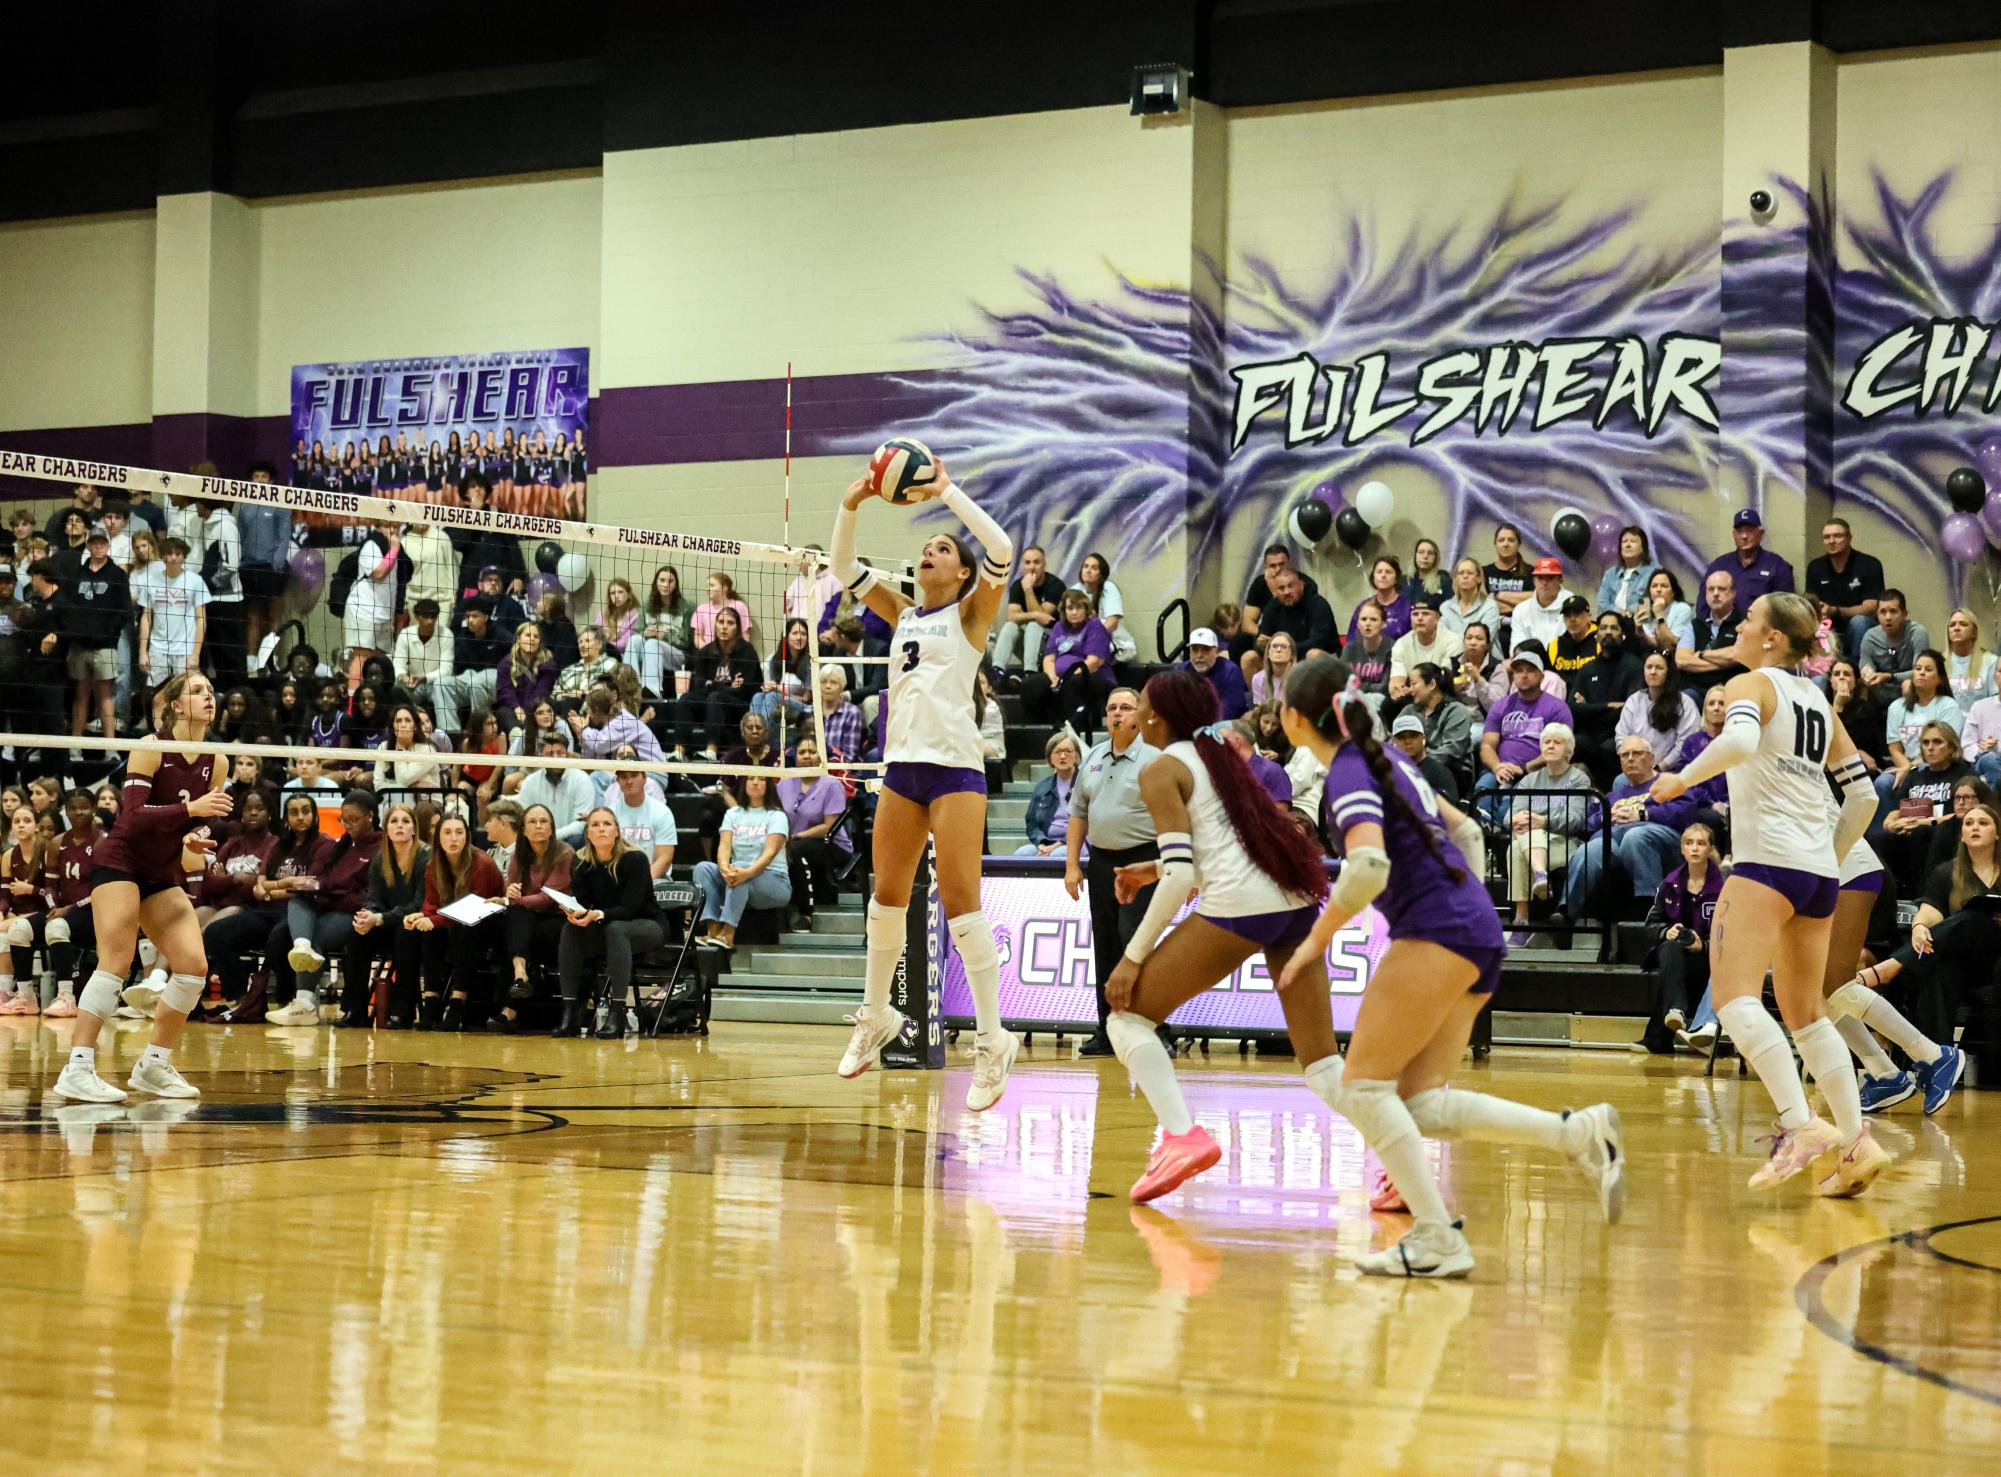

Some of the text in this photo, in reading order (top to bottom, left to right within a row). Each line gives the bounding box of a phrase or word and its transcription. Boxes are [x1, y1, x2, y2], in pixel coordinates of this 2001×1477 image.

[299, 363, 581, 431] FULSHEAR
[1231, 322, 2001, 450] FULSHEAR CH
[0, 452, 128, 483] EAR CHARGERS
[201, 477, 360, 512] FULSHEAR CHARGERS
[423, 505, 562, 535] FULSHEAR CHARGERS
[618, 528, 742, 556] FULSHEAR CHARGERS
[902, 641, 920, 673] 3
[1793, 701, 1826, 765] 10
[65, 861, 81, 881] 14
[653, 890, 694, 903] ARGERS
[926, 831, 941, 1047] HARGERS
